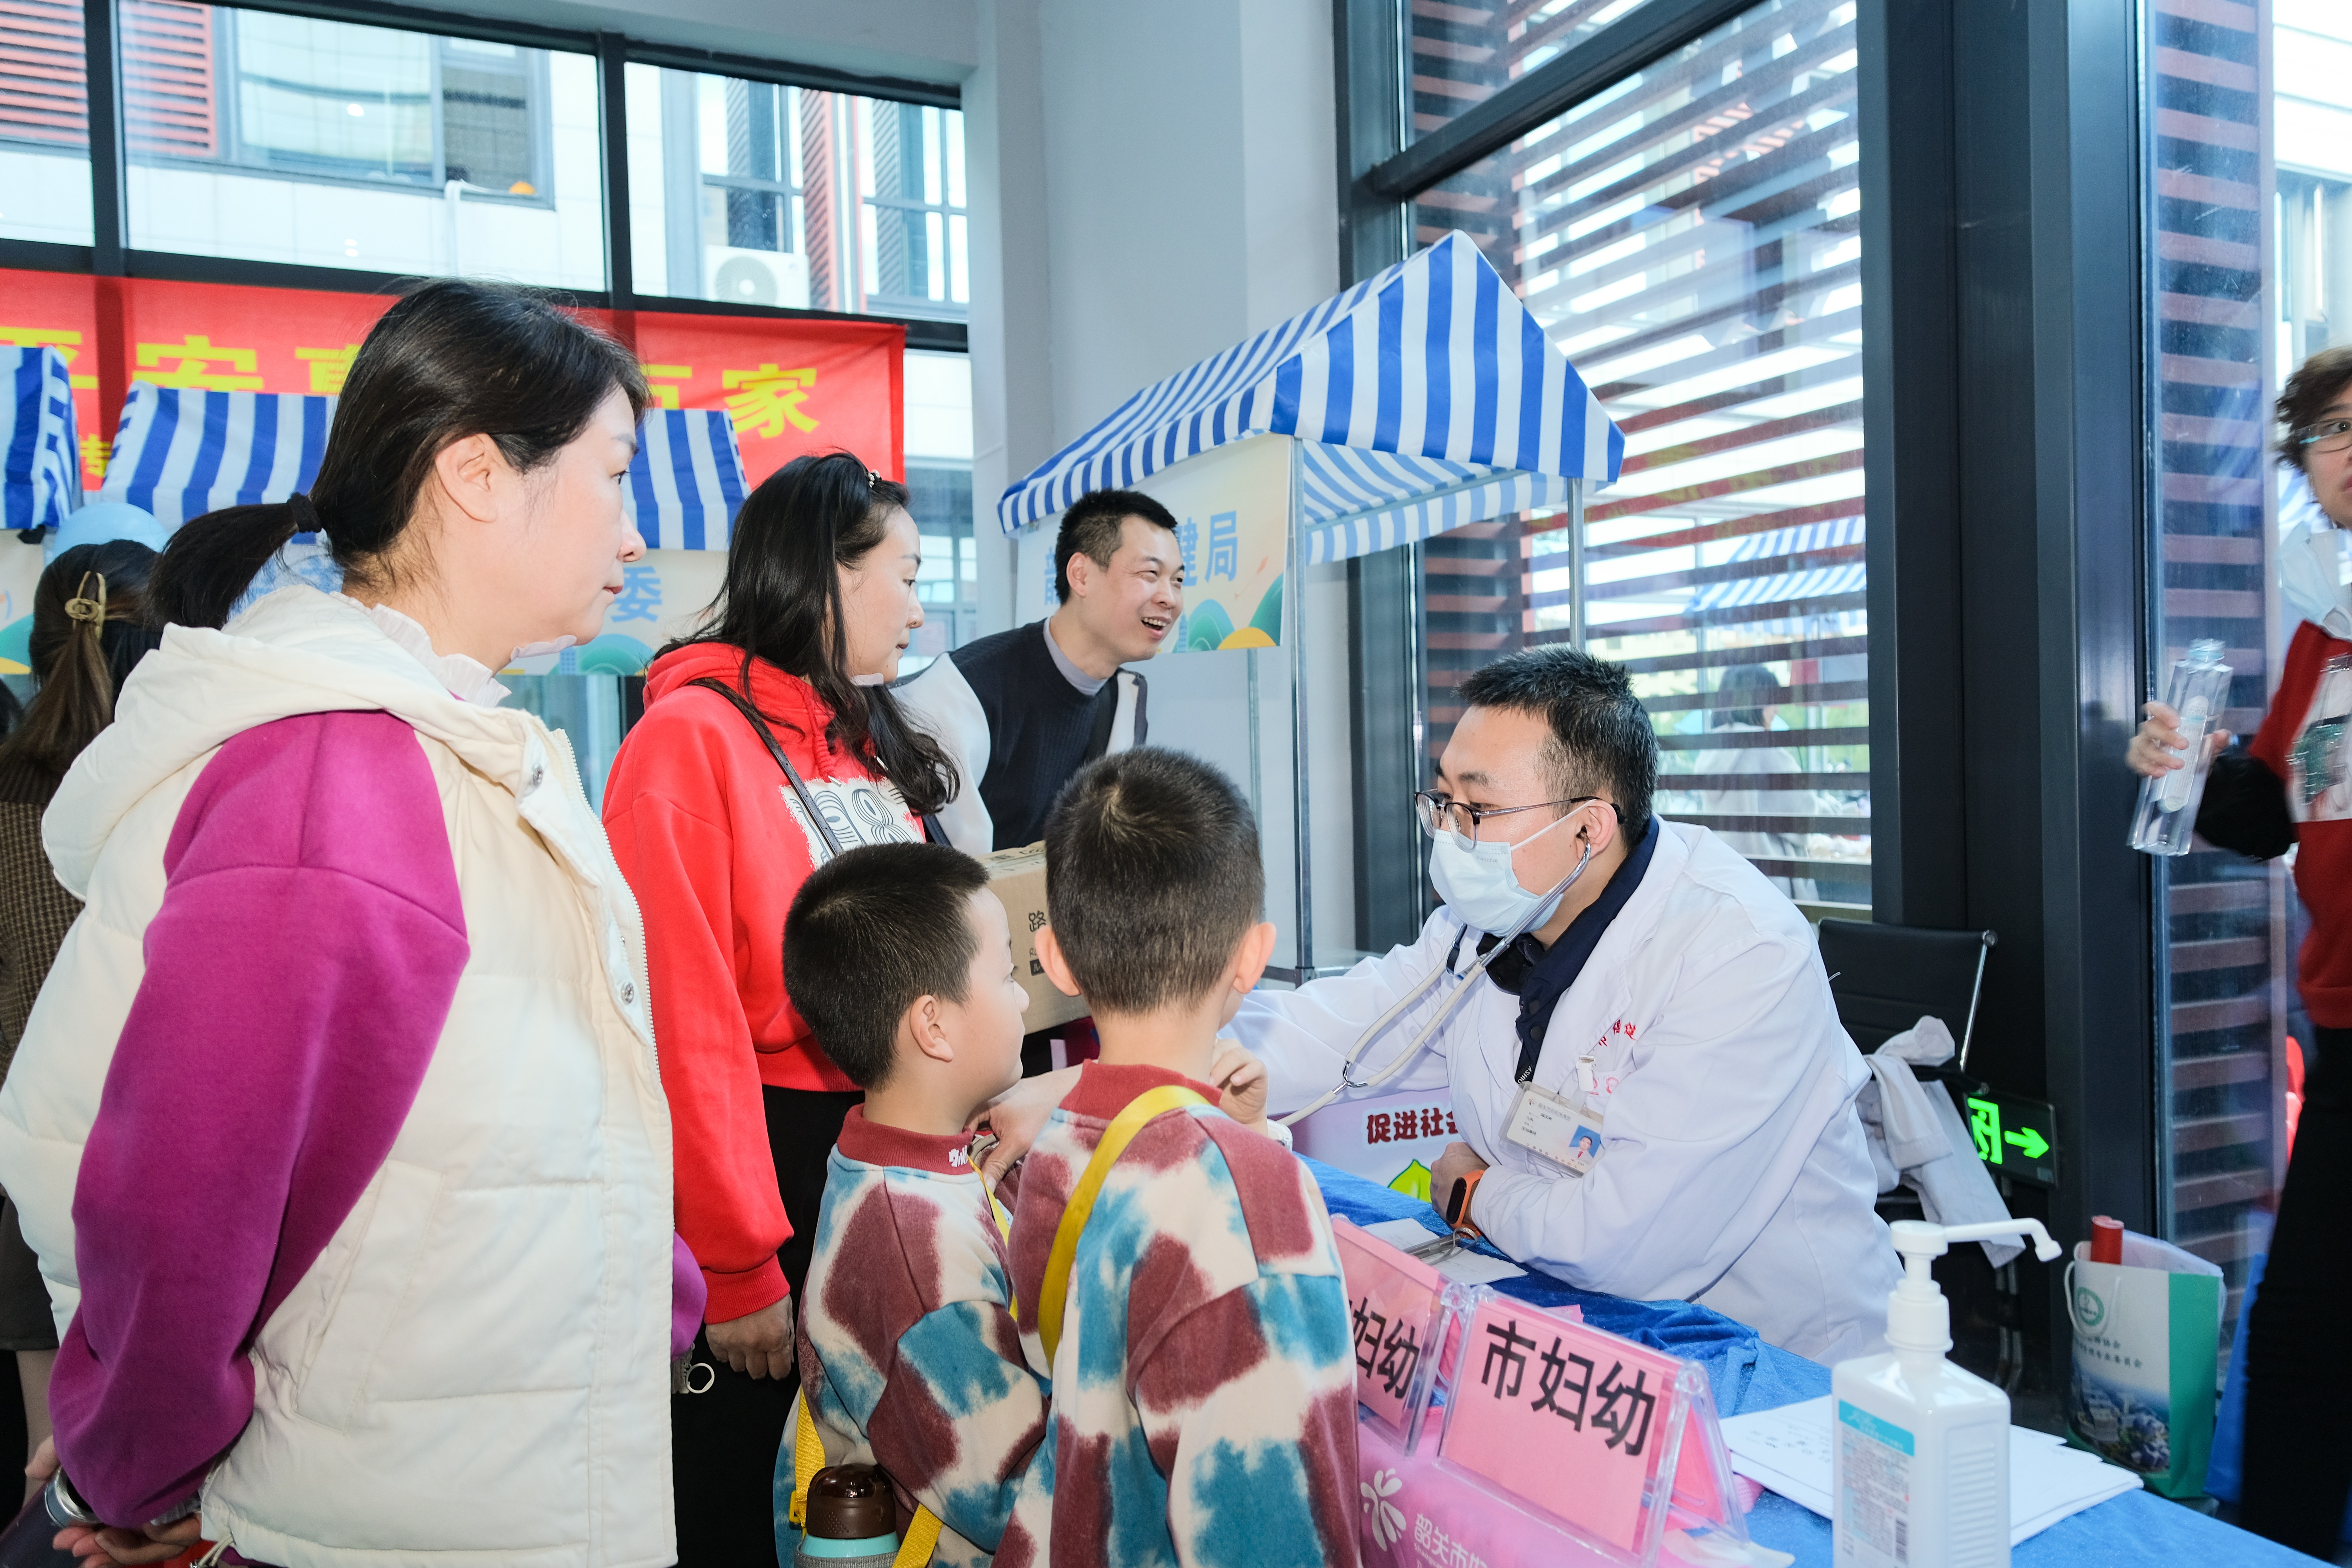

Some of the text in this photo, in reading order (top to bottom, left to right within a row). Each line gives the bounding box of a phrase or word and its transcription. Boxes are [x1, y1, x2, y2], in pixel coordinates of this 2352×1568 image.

[611, 566, 663, 623] 委
[1349, 1297, 1420, 1399] 妇幼
[1481, 1320, 1656, 1456] 市妇幼
